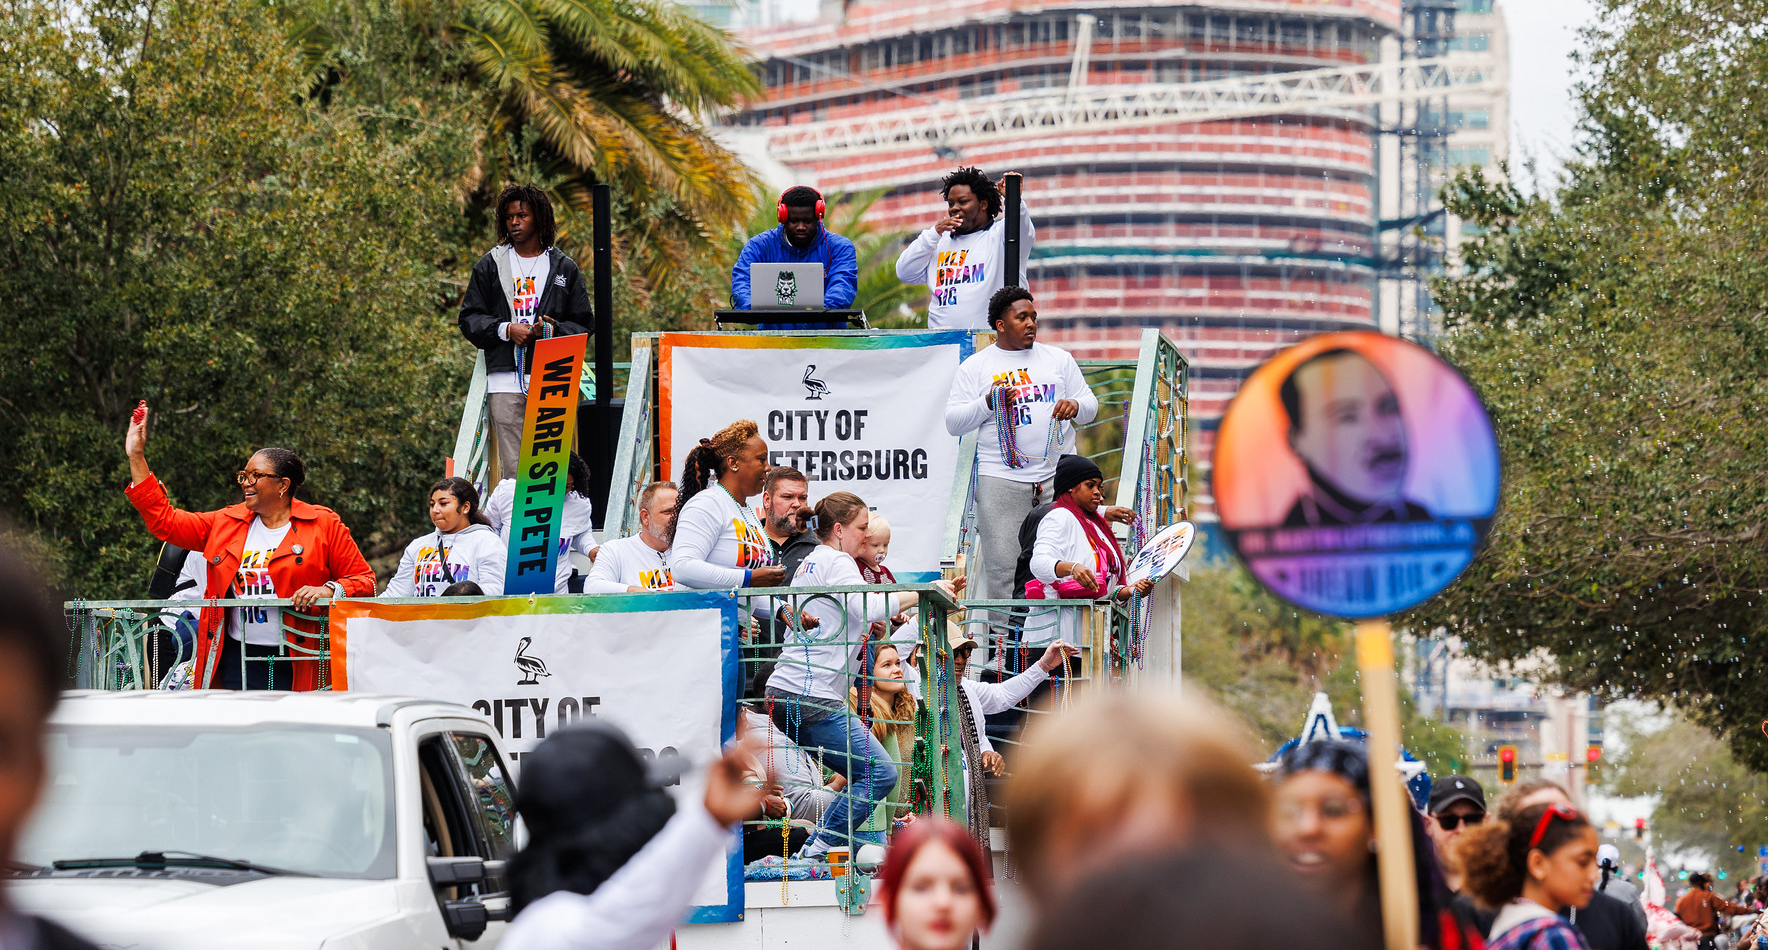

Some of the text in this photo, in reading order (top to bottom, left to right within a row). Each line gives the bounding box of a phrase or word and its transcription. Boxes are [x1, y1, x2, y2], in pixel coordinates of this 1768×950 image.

[935, 262, 985, 287] DREAM
[540, 355, 575, 401] WE
[1012, 384, 1056, 406] REAM
[531, 406, 567, 456] ARE
[767, 409, 868, 441] CITY OF
[471, 697, 550, 739] CITY
